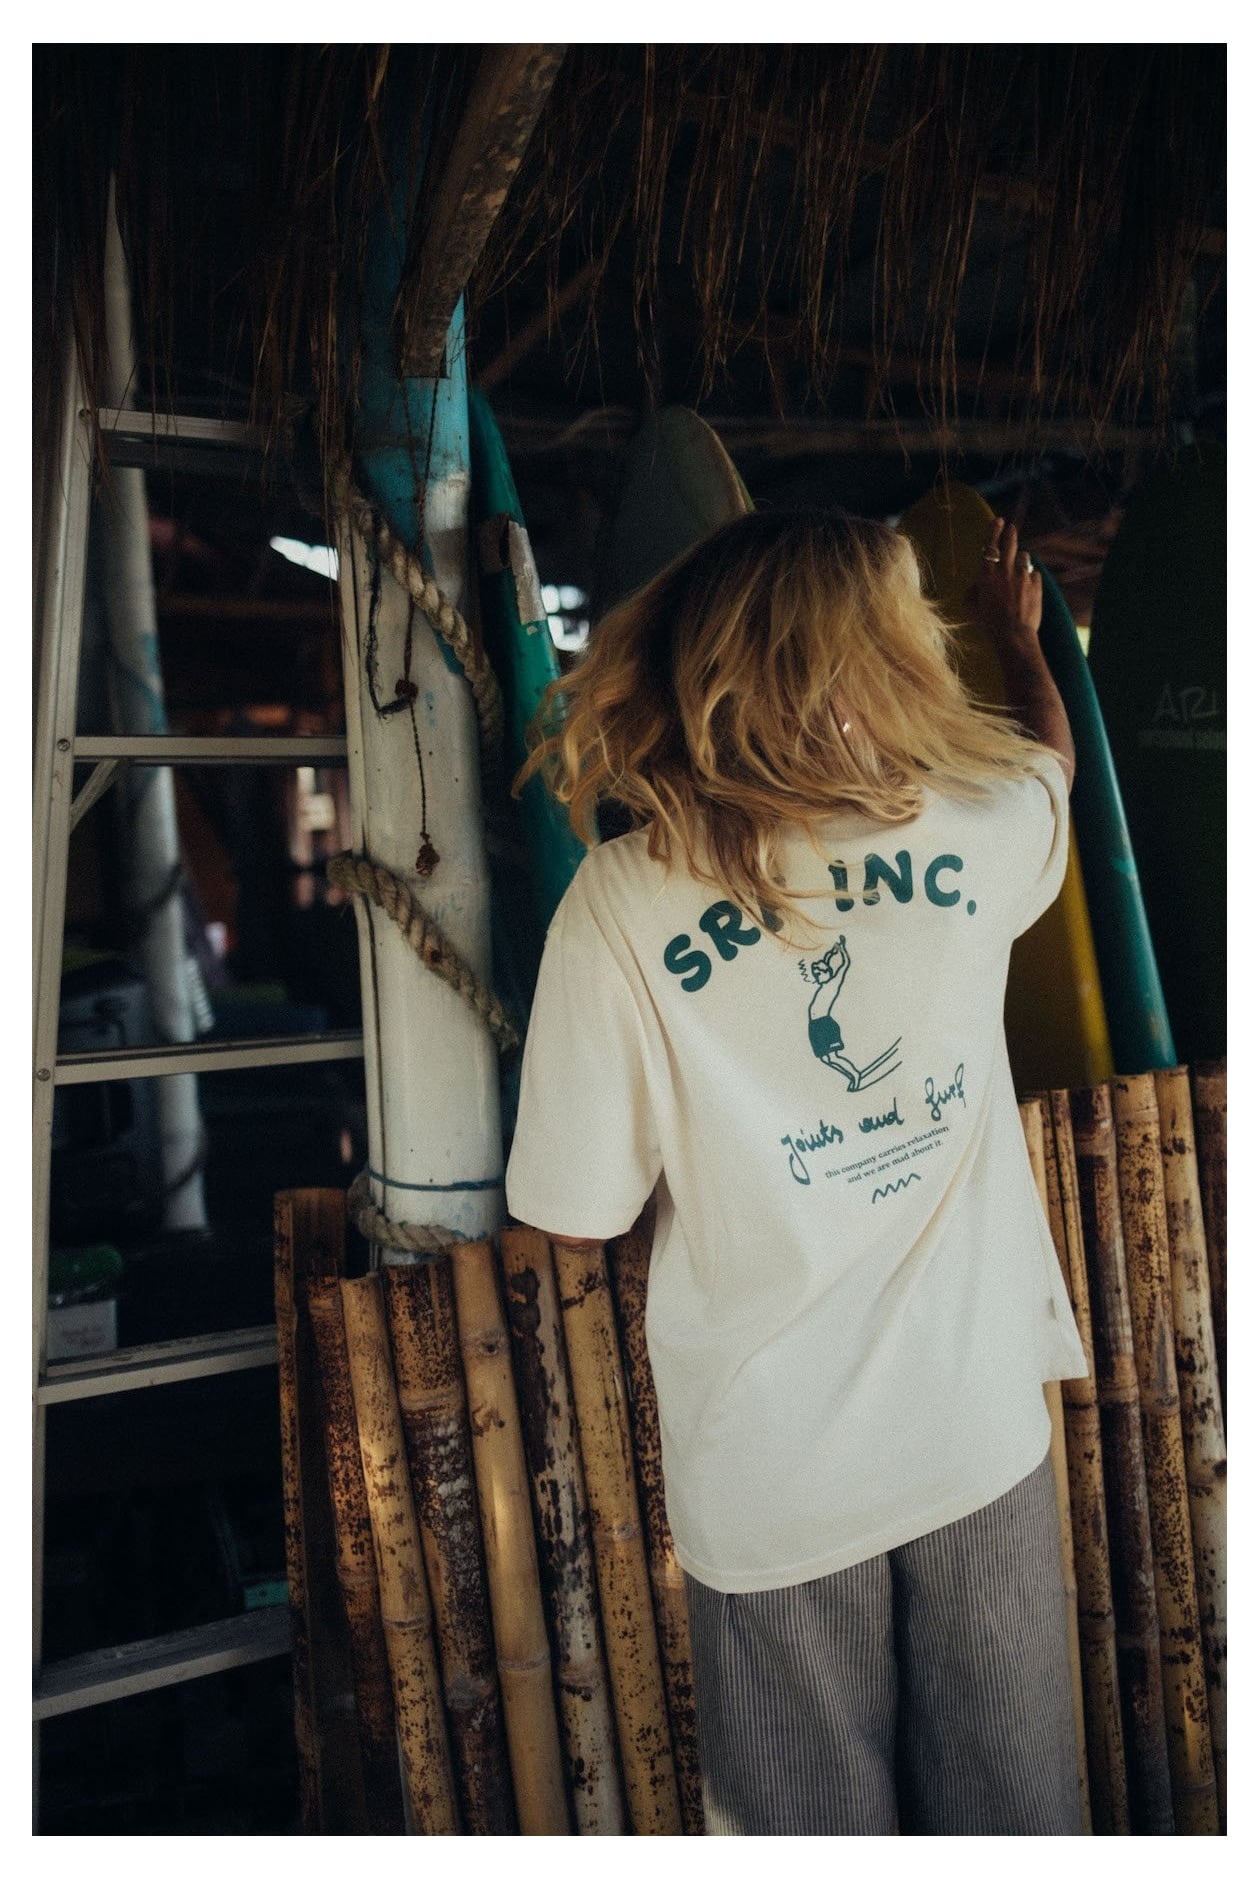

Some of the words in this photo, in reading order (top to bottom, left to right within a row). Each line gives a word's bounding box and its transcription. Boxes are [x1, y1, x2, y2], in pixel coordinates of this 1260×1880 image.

[827, 849, 978, 916] INC.
[858, 1097, 905, 1133] and
[825, 1170, 841, 1180] this
[841, 1155, 877, 1174] company
[878, 1144, 906, 1159] carries
[907, 1125, 950, 1147] relaxation
[847, 1173, 862, 1184] and
[863, 1169, 876, 1178] we
[877, 1163, 890, 1172] are
[891, 1154, 910, 1166] mad
[911, 1143, 934, 1158] about
